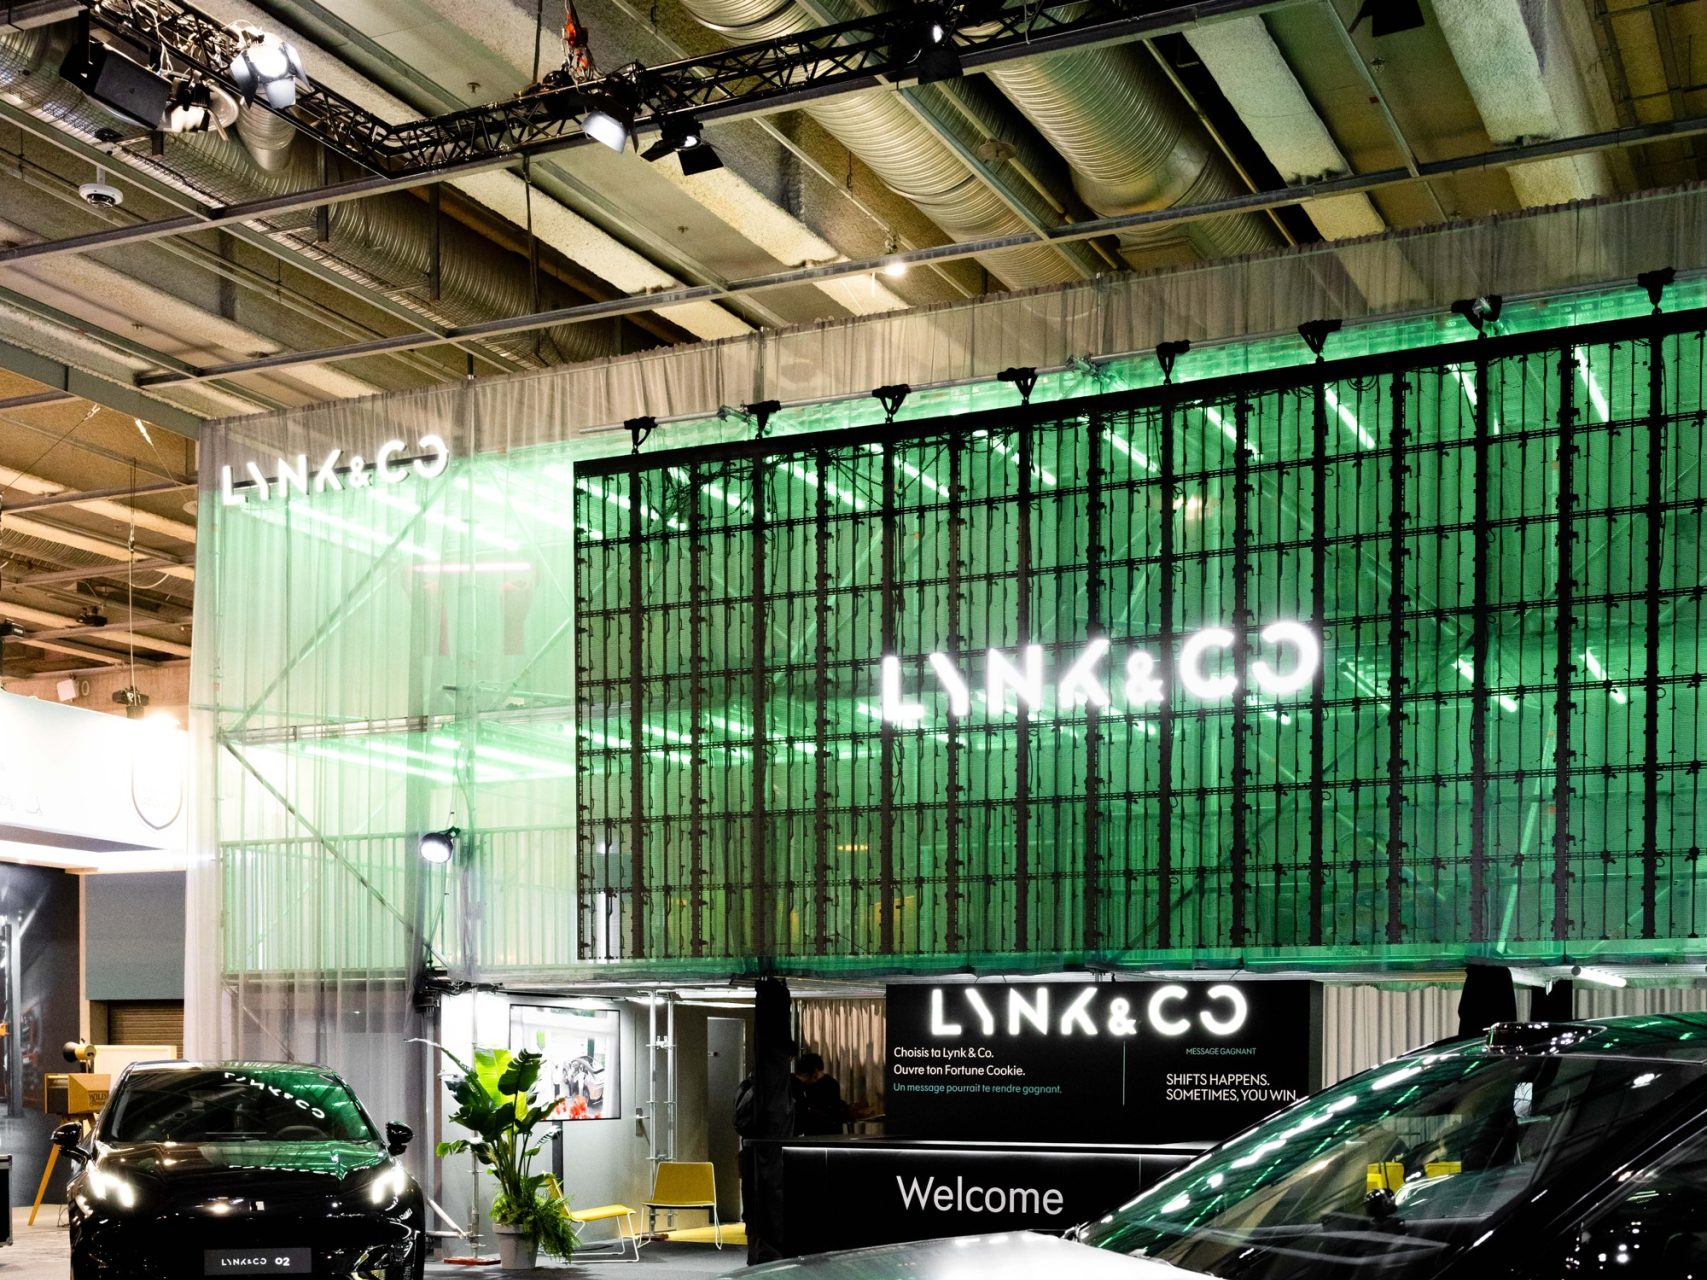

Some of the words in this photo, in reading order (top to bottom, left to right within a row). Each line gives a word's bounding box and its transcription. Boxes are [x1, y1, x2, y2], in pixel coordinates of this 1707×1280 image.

[222, 434, 449, 505] LYNK&CO
[881, 621, 1319, 722] LYNK&CO
[931, 984, 1247, 1036] LYNK&CO
[893, 1047, 930, 1058] Choisis
[930, 1047, 941, 1058] ta
[942, 1047, 967, 1060] Lynk
[967, 1048, 977, 1058] &
[977, 1047, 994, 1058] Co.
[1185, 1047, 1219, 1055] MESSAGE
[1219, 1047, 1257, 1055] GAGNANT
[893, 1064, 925, 1075] Ouvre
[926, 1065, 943, 1075] ton
[944, 1064, 985, 1076] Fortune
[986, 1064, 1026, 1076] Cookie.
[1166, 1073, 1208, 1086] SHIFTS
[1209, 1073, 1270, 1086] HAPPENS.
[893, 1082, 906, 1092] Un
[907, 1084, 945, 1094] message
[946, 1083, 981, 1094] pourrait
[982, 1084, 991, 1093] te
[992, 1084, 1022, 1093] rendre
[1022, 1085, 1063, 1096] gagnant.
[1166, 1088, 1240, 1102] SOMETIMES,
[1240, 1089, 1268, 1102] YOU
[896, 1175, 1064, 1215] Welcome
[221, 1257, 268, 1267] LYNK&CO
[275, 1256, 291, 1267] 02
